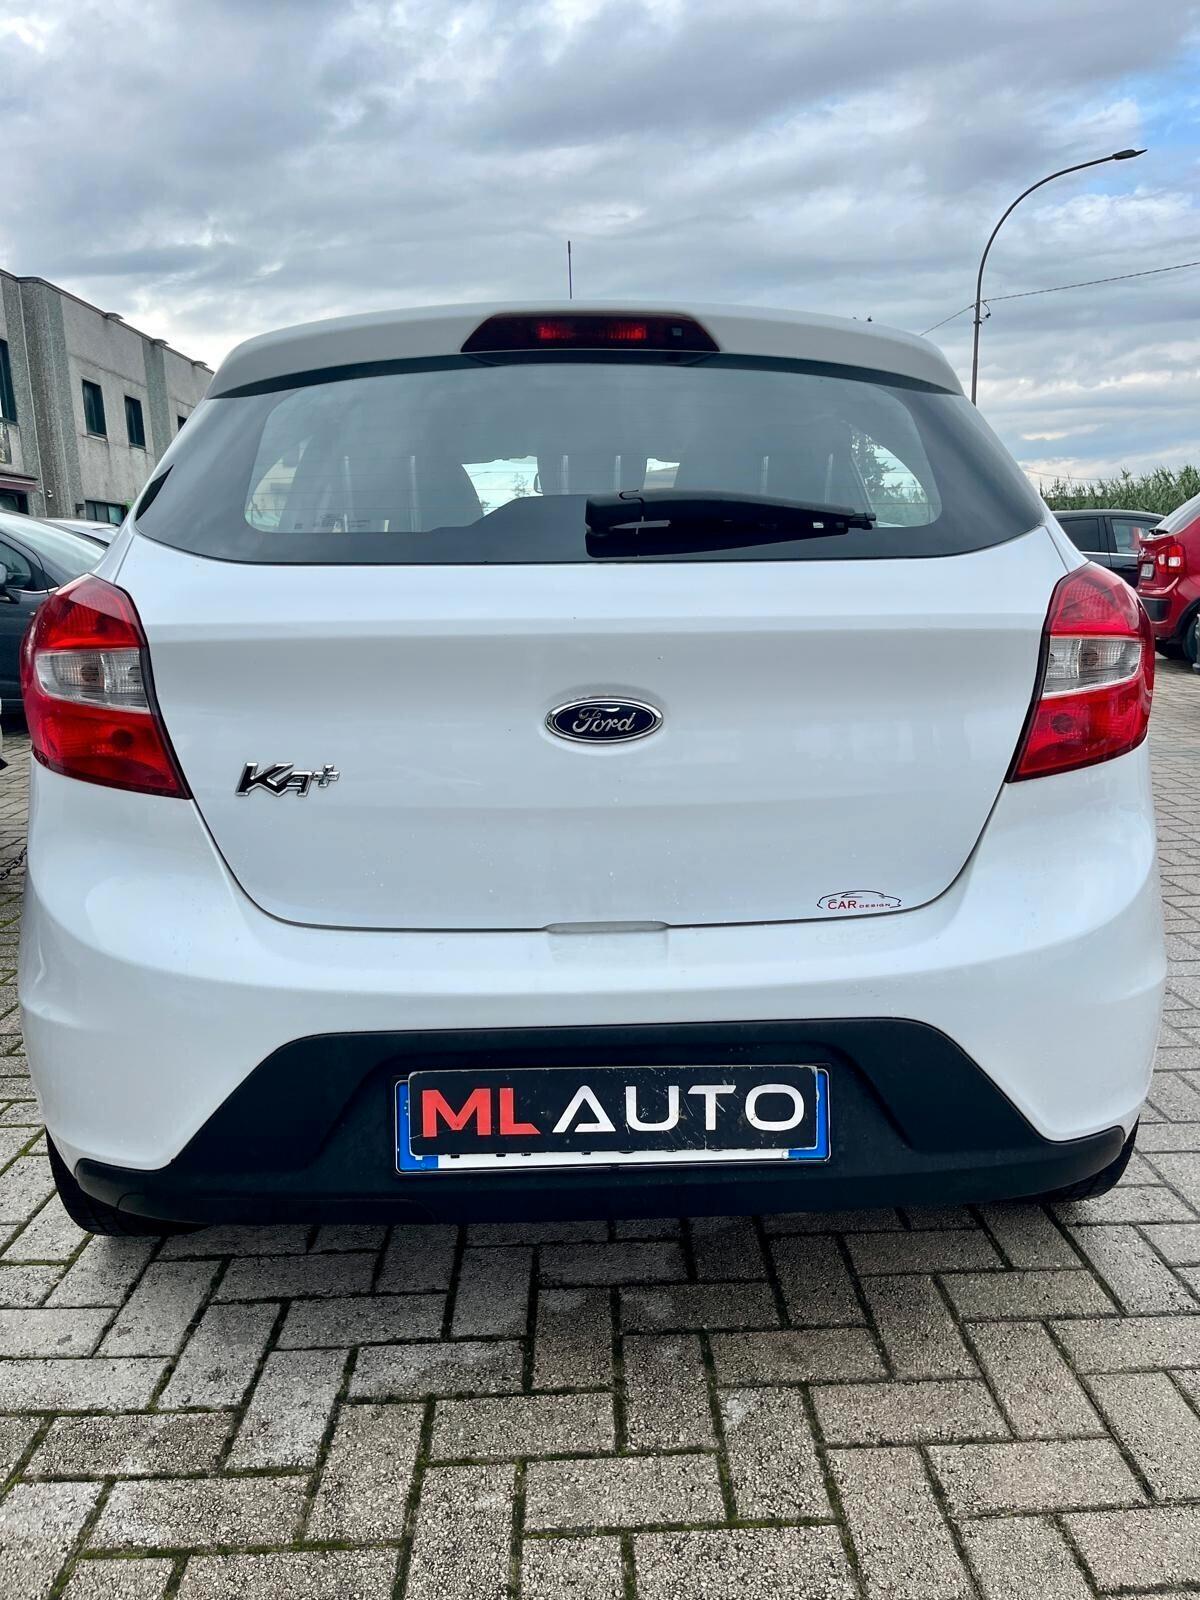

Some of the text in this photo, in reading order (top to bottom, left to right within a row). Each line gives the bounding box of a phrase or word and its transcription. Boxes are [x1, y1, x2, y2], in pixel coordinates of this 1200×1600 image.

[572, 706, 636, 732] Ford
[827, 899, 857, 909] CAR
[421, 1084, 805, 1137] ML AUTO
